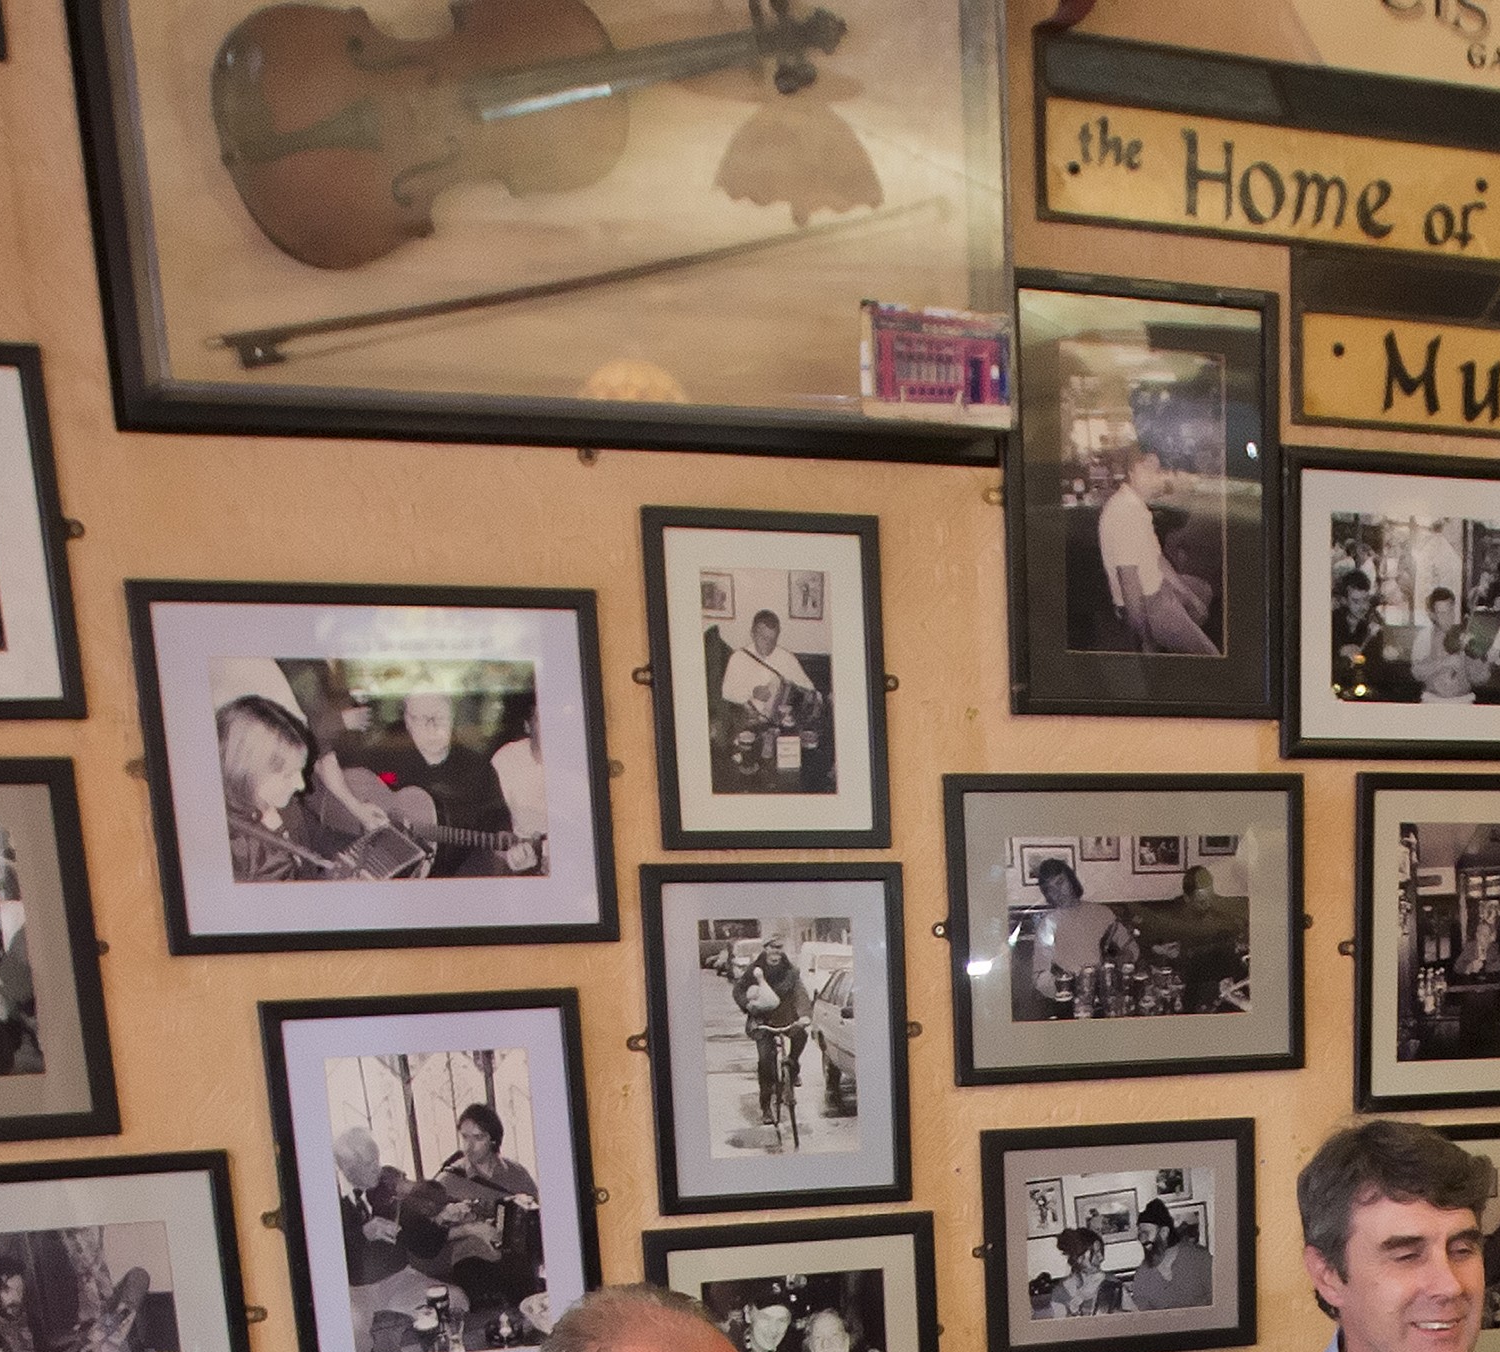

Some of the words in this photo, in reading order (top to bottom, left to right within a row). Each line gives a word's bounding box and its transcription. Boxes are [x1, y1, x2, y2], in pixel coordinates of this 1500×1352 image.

[1078, 116, 1143, 171] the
[1182, 126, 1394, 239] Home
[1423, 200, 1487, 248] of
